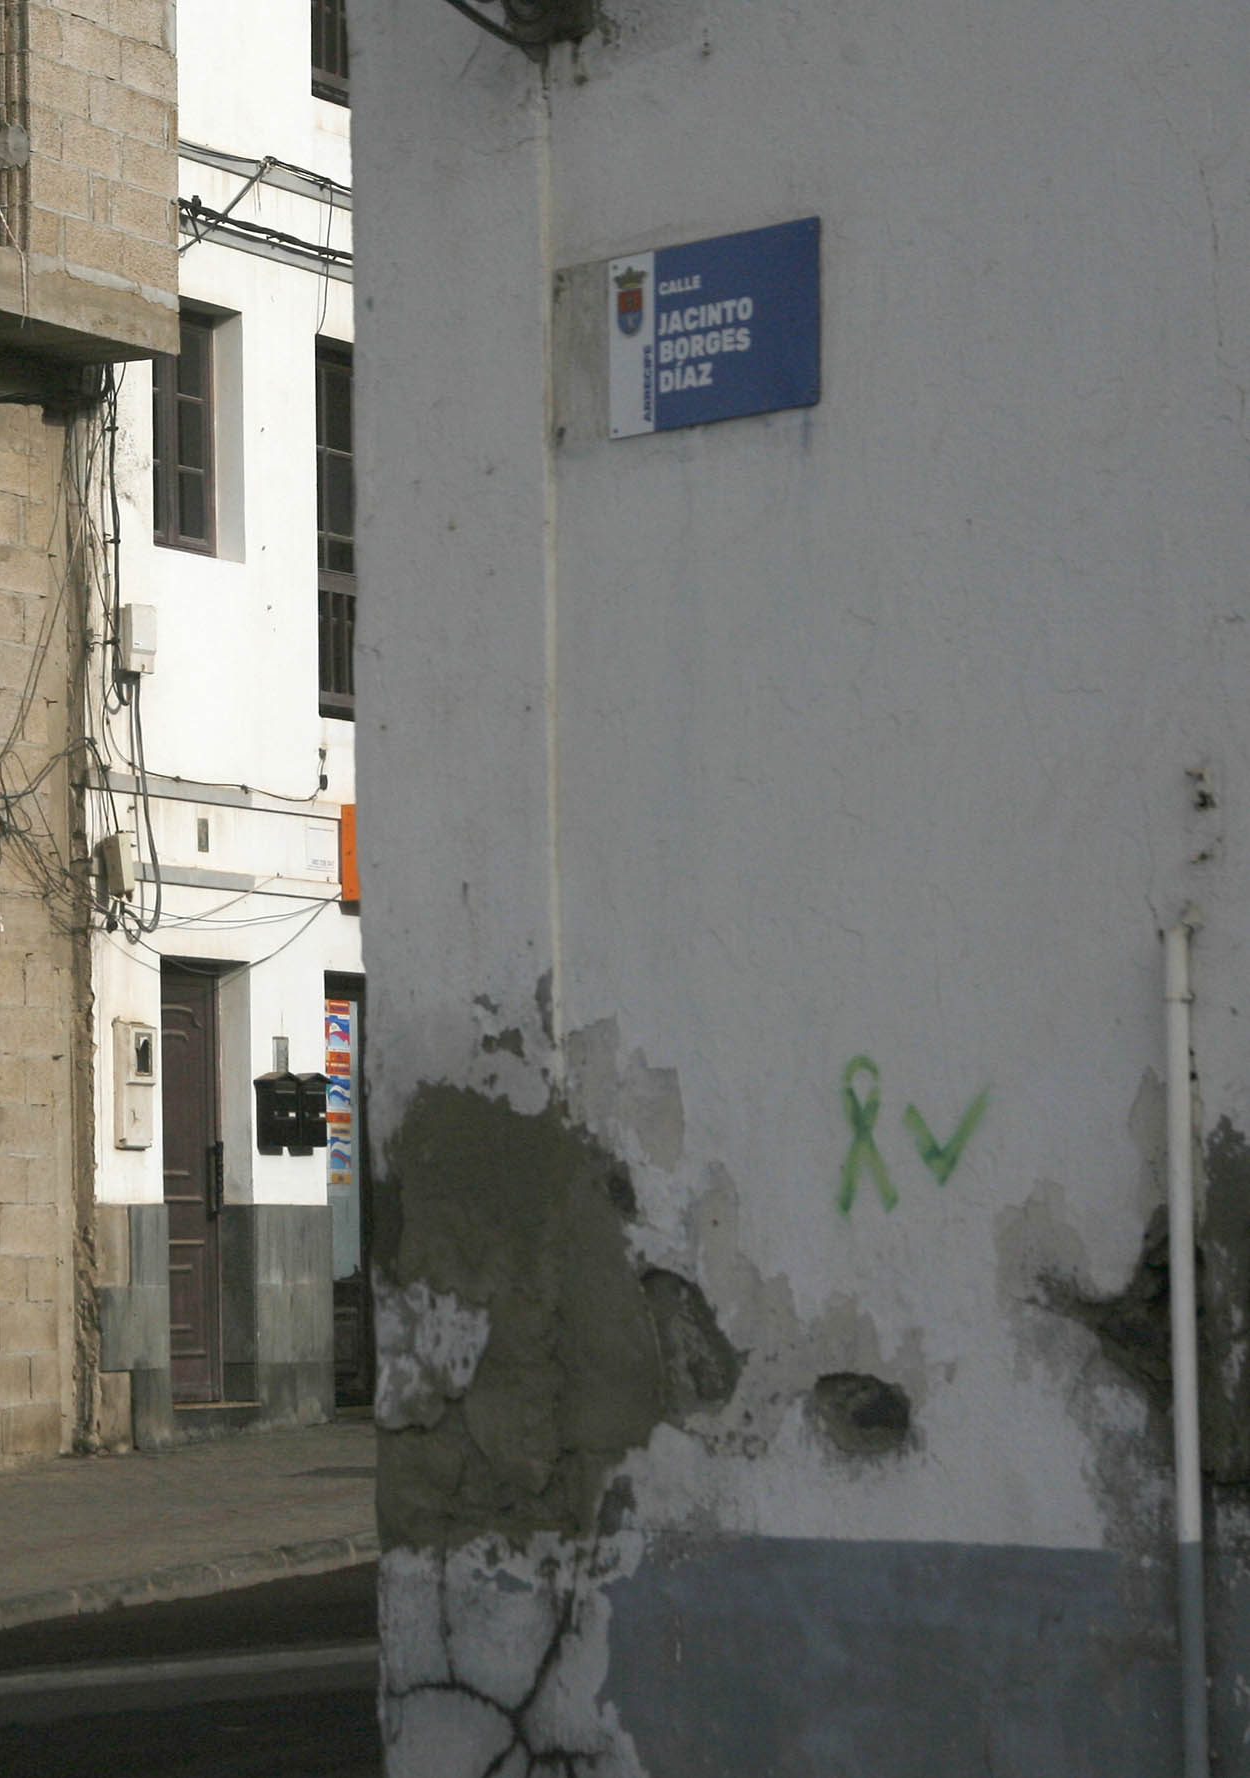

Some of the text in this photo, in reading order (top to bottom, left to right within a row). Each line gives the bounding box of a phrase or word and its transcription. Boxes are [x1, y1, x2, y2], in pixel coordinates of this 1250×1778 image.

[659, 274, 701, 296] CALLE
[658, 296, 753, 336] JACINTO
[659, 327, 751, 364] BORGES
[659, 361, 713, 393] DÍAZ
